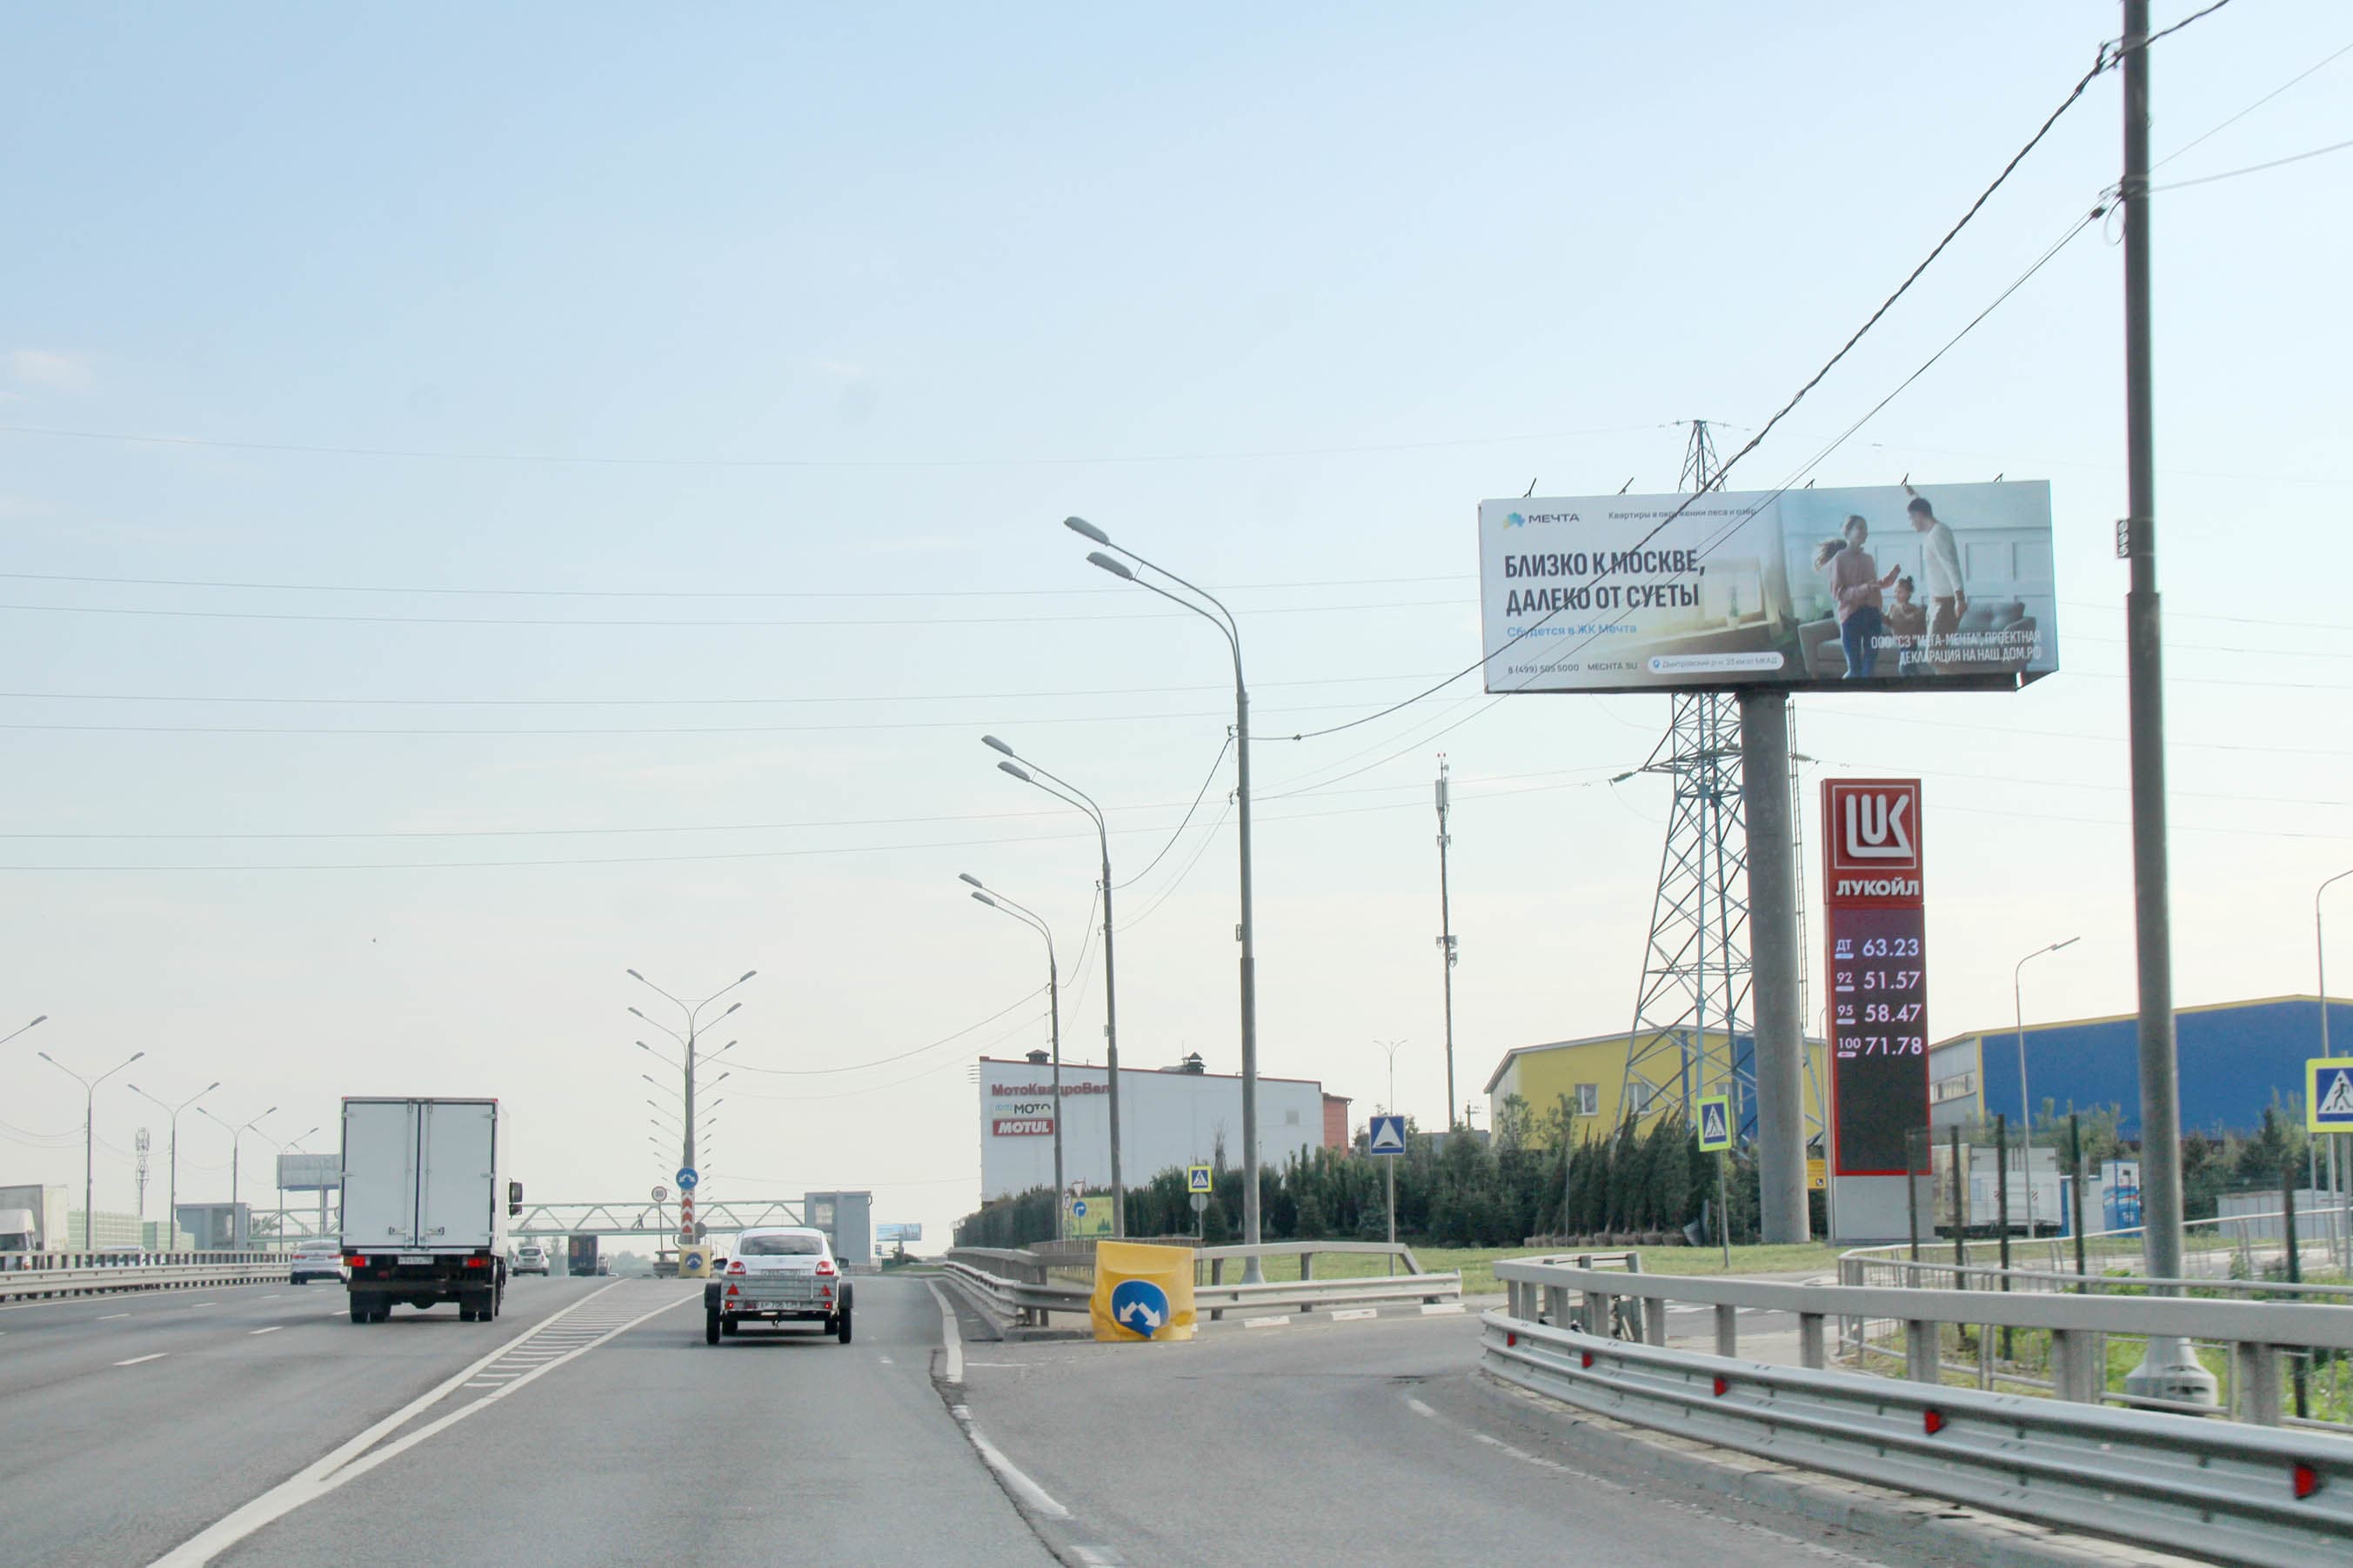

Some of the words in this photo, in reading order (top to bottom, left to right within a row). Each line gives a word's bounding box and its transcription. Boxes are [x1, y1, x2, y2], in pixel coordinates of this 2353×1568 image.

[1528, 513, 1580, 524] МЕЧТА
[1608, 511, 1650, 520] Квартиры
[1659, 510, 1706, 520] окржении
[1505, 553, 1588, 578] БЛИЗКО
[1593, 552, 1606, 575] К
[1611, 549, 1705, 577] МОСКВЕ,
[1506, 587, 1591, 617] ДАЛЕКО
[1595, 585, 1621, 609] ОТ
[1626, 584, 1699, 608] СУЕТЫ
[1507, 625, 1566, 639] Сбудется
[1578, 624, 1597, 635] ЖК
[1598, 624, 1637, 635] Мечта
[1871, 636, 1893, 650] ООО
[1985, 630, 2041, 644] ПРОЕКТНАЯ
[1899, 649, 1961, 666] ДЕКЛАРАЦИЯ
[1962, 649, 1976, 661] НА
[1835, 877, 1920, 896] ЛУКОЙЛ
[1836, 939, 1852, 952] ДТ
[1862, 938, 1919, 957] 63.23
[1836, 972, 1852, 984] 92
[1863, 971, 1921, 990] 51.57
[1837, 1004, 1854, 1016] 95
[1864, 1004, 1922, 1022] 58.47
[1838, 1038, 1862, 1049] 100
[1864, 1037, 1922, 1055] 71.78
[998, 1121, 1049, 1134] MOTUL
